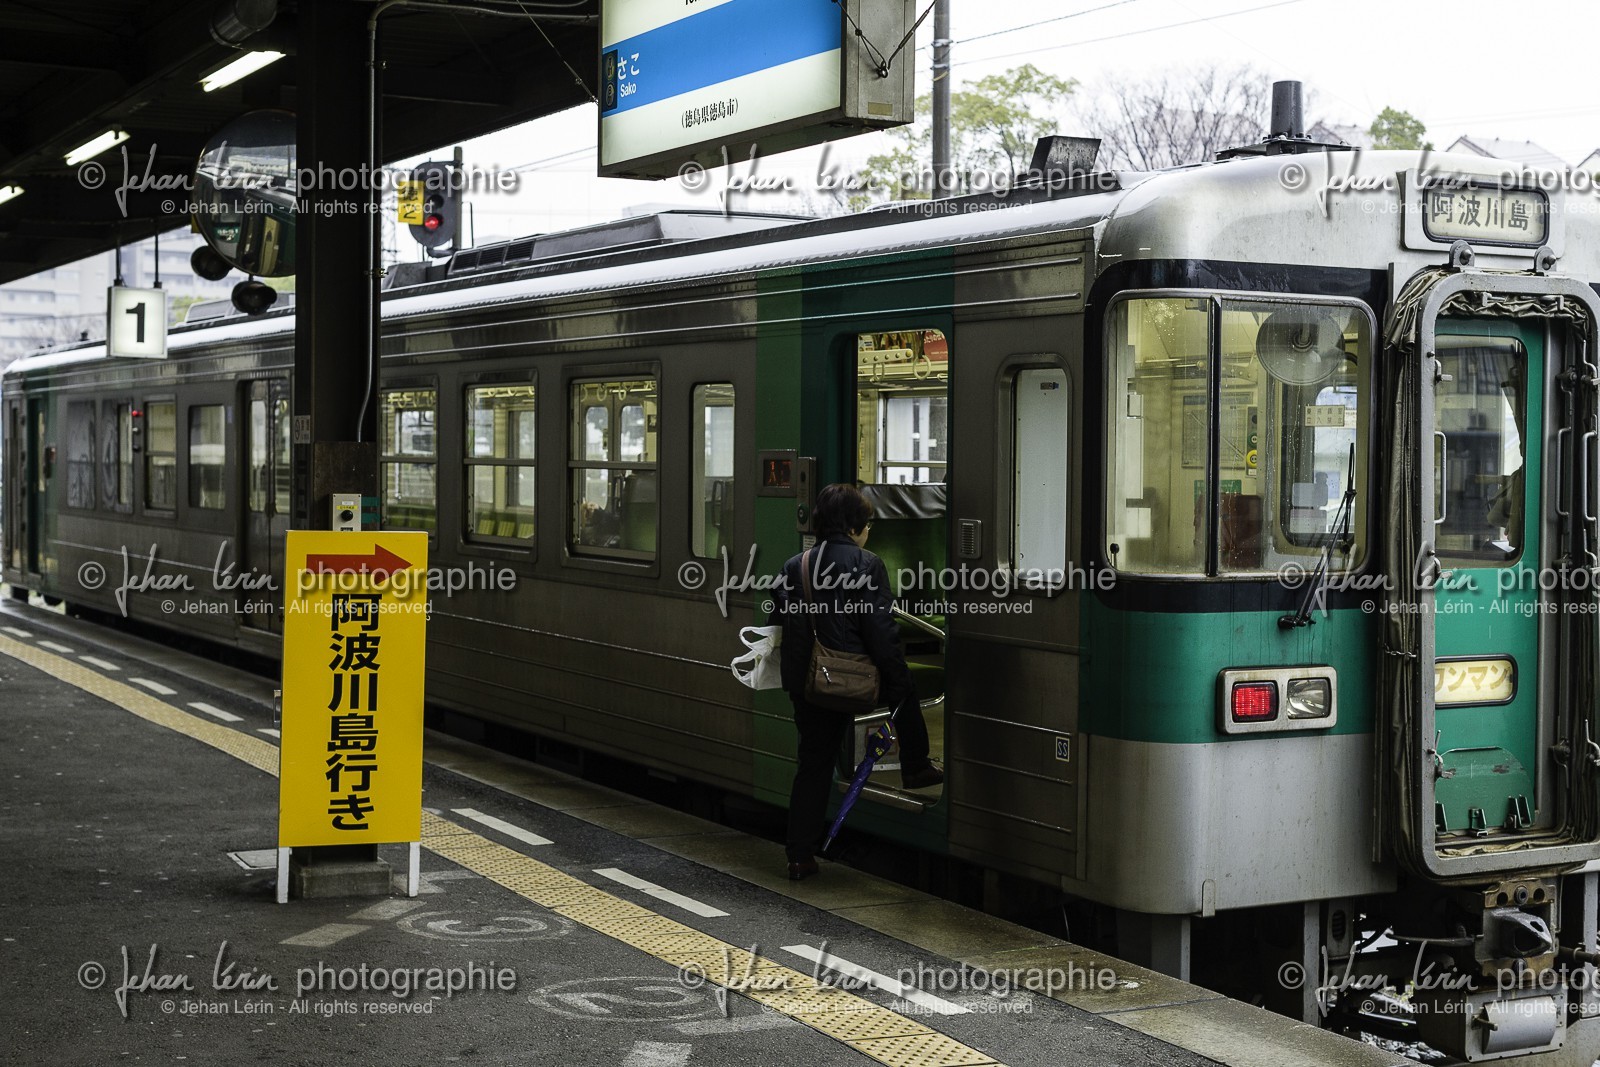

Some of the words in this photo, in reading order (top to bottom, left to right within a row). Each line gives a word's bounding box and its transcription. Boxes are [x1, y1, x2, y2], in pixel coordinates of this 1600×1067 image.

[617, 52, 640, 80] さこ
[620, 81, 637, 97] Sako
[1431, 193, 1530, 231] 阿波川島
[126, 303, 145, 343] 1
[325, 593, 382, 830] 阿波川島行き
[1057, 741, 1068, 757] SS
